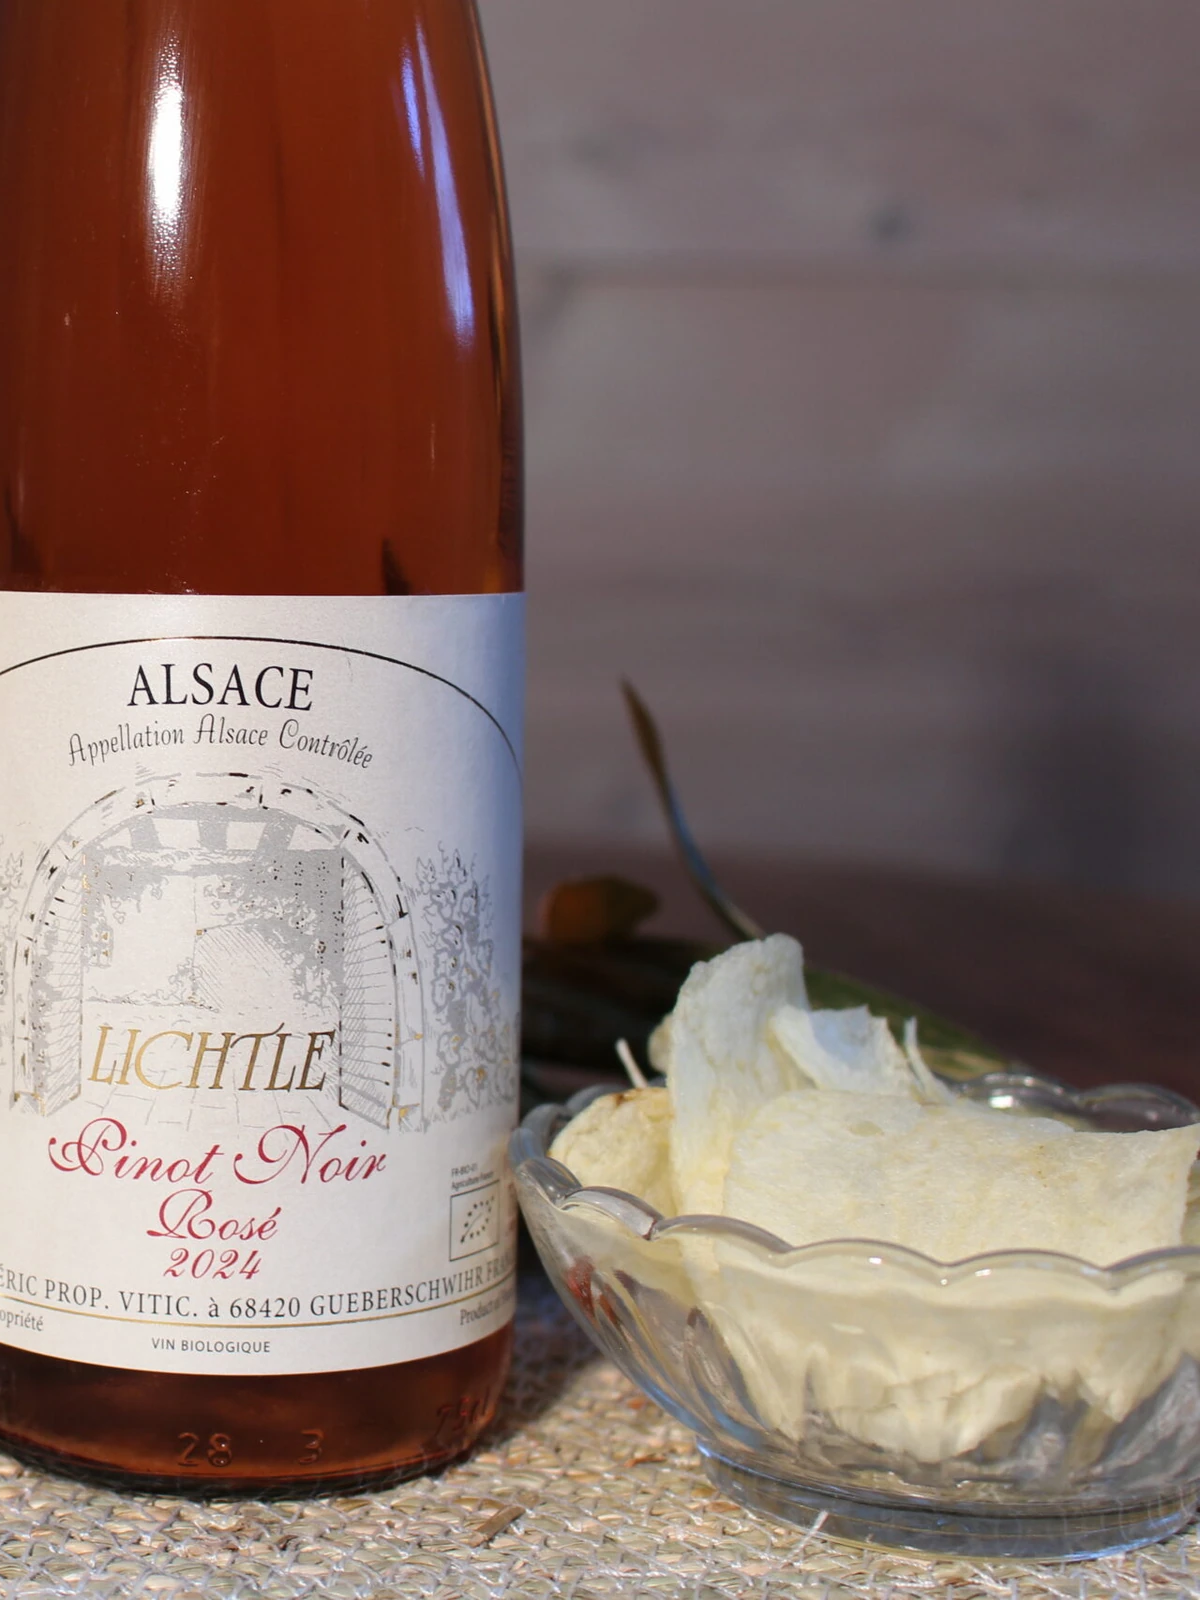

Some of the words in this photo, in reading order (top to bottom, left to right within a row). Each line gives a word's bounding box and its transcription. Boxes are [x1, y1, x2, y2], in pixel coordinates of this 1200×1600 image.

[126, 662, 315, 712] ALSACE
[68, 721, 185, 768] Appellation
[193, 713, 269, 747] Alsace
[278, 718, 374, 771] Contrôlée
[48, 1117, 224, 1186] Pinot
[233, 1123, 388, 1186] Noir
[146, 1187, 281, 1242] Rosé
[162, 1246, 263, 1282] 2024
[43, 1278, 109, 1310] PROP.
[119, 1290, 198, 1318] VITIC.
[208, 1297, 220, 1318] à
[229, 1296, 301, 1319] 68420
[309, 1265, 484, 1316] GUEBERSCHWIHR
[150, 1336, 178, 1353] VIN
[180, 1338, 272, 1356] BIOLOGIQUE
[177, 1431, 233, 1467] 28
